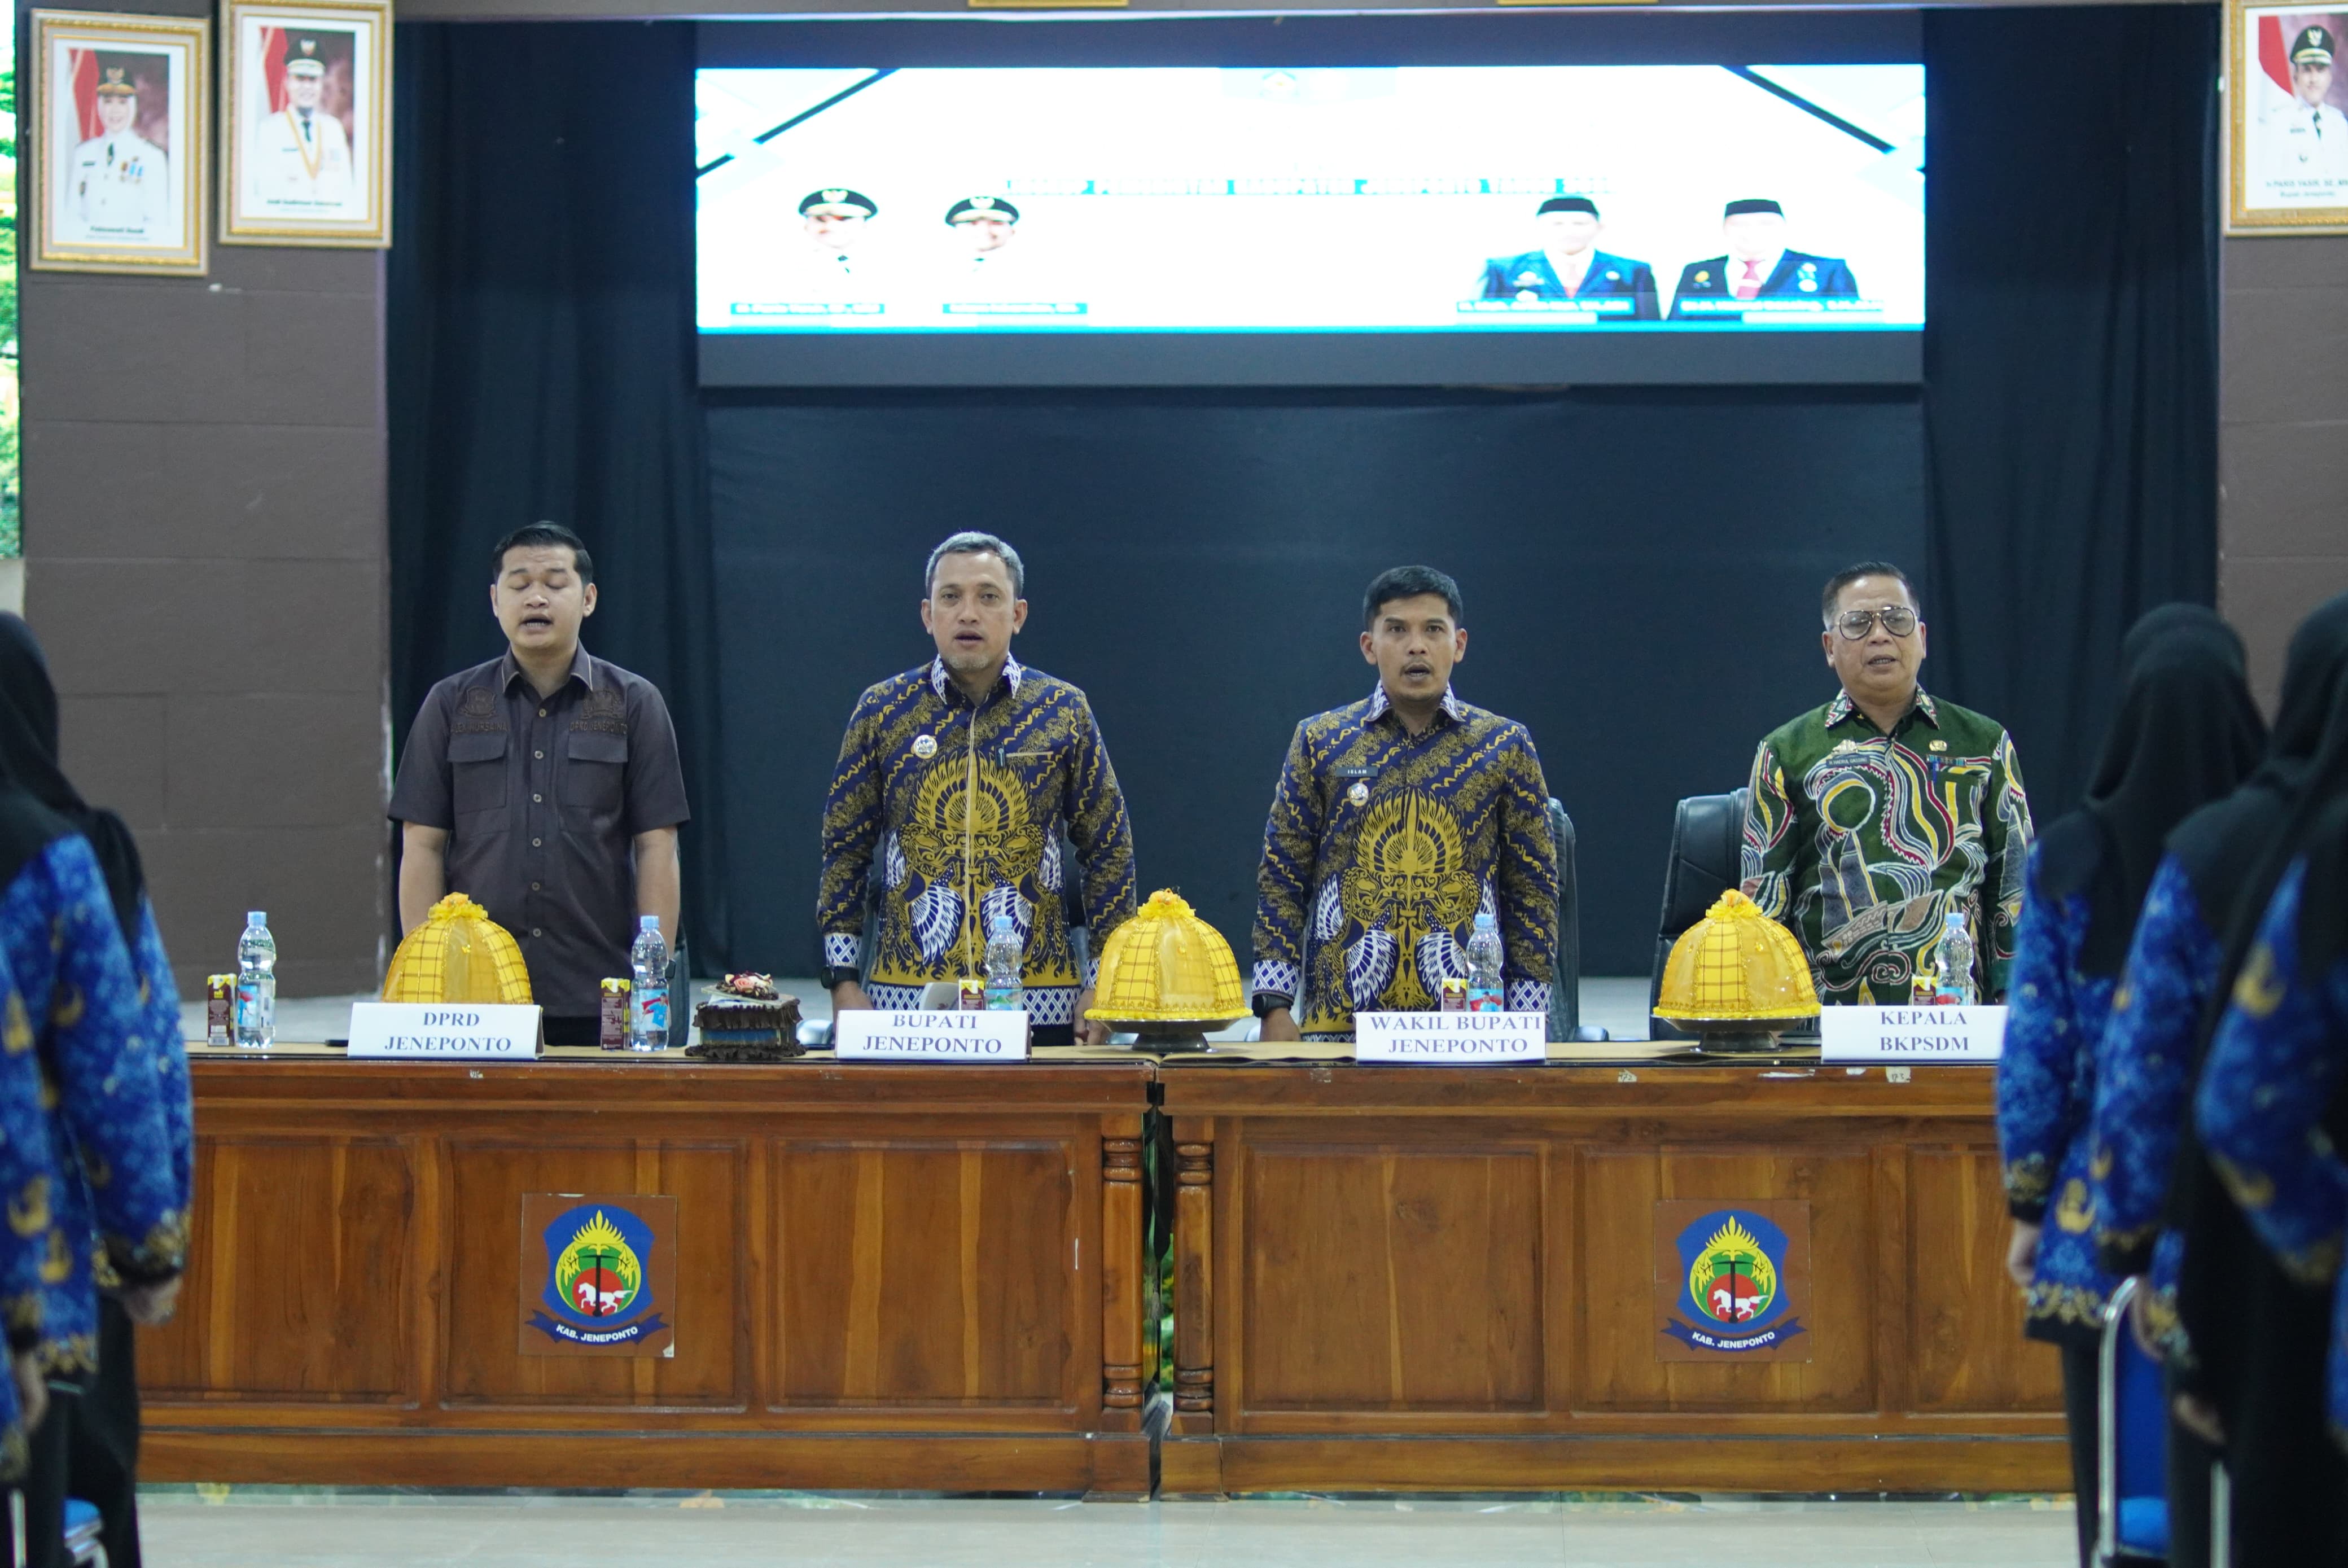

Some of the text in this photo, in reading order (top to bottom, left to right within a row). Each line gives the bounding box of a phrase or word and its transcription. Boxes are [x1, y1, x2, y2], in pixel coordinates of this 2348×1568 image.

[424, 1012, 480, 1026] DPRD
[893, 1014, 977, 1029] BUPATI
[1370, 1017, 1540, 1030] WAKIL BUPATI
[1881, 1011, 1967, 1024] KEPALA
[384, 1036, 511, 1051] JENEPONTO
[863, 1036, 1002, 1053] JENEPONTO
[1388, 1039, 1527, 1053] JENEPONTO
[1881, 1037, 1968, 1051] BKPSDM
[556, 1324, 638, 1343] KAB. JENEPONTO
[1692, 1331, 1775, 1348] KAB. JENEPONTO
